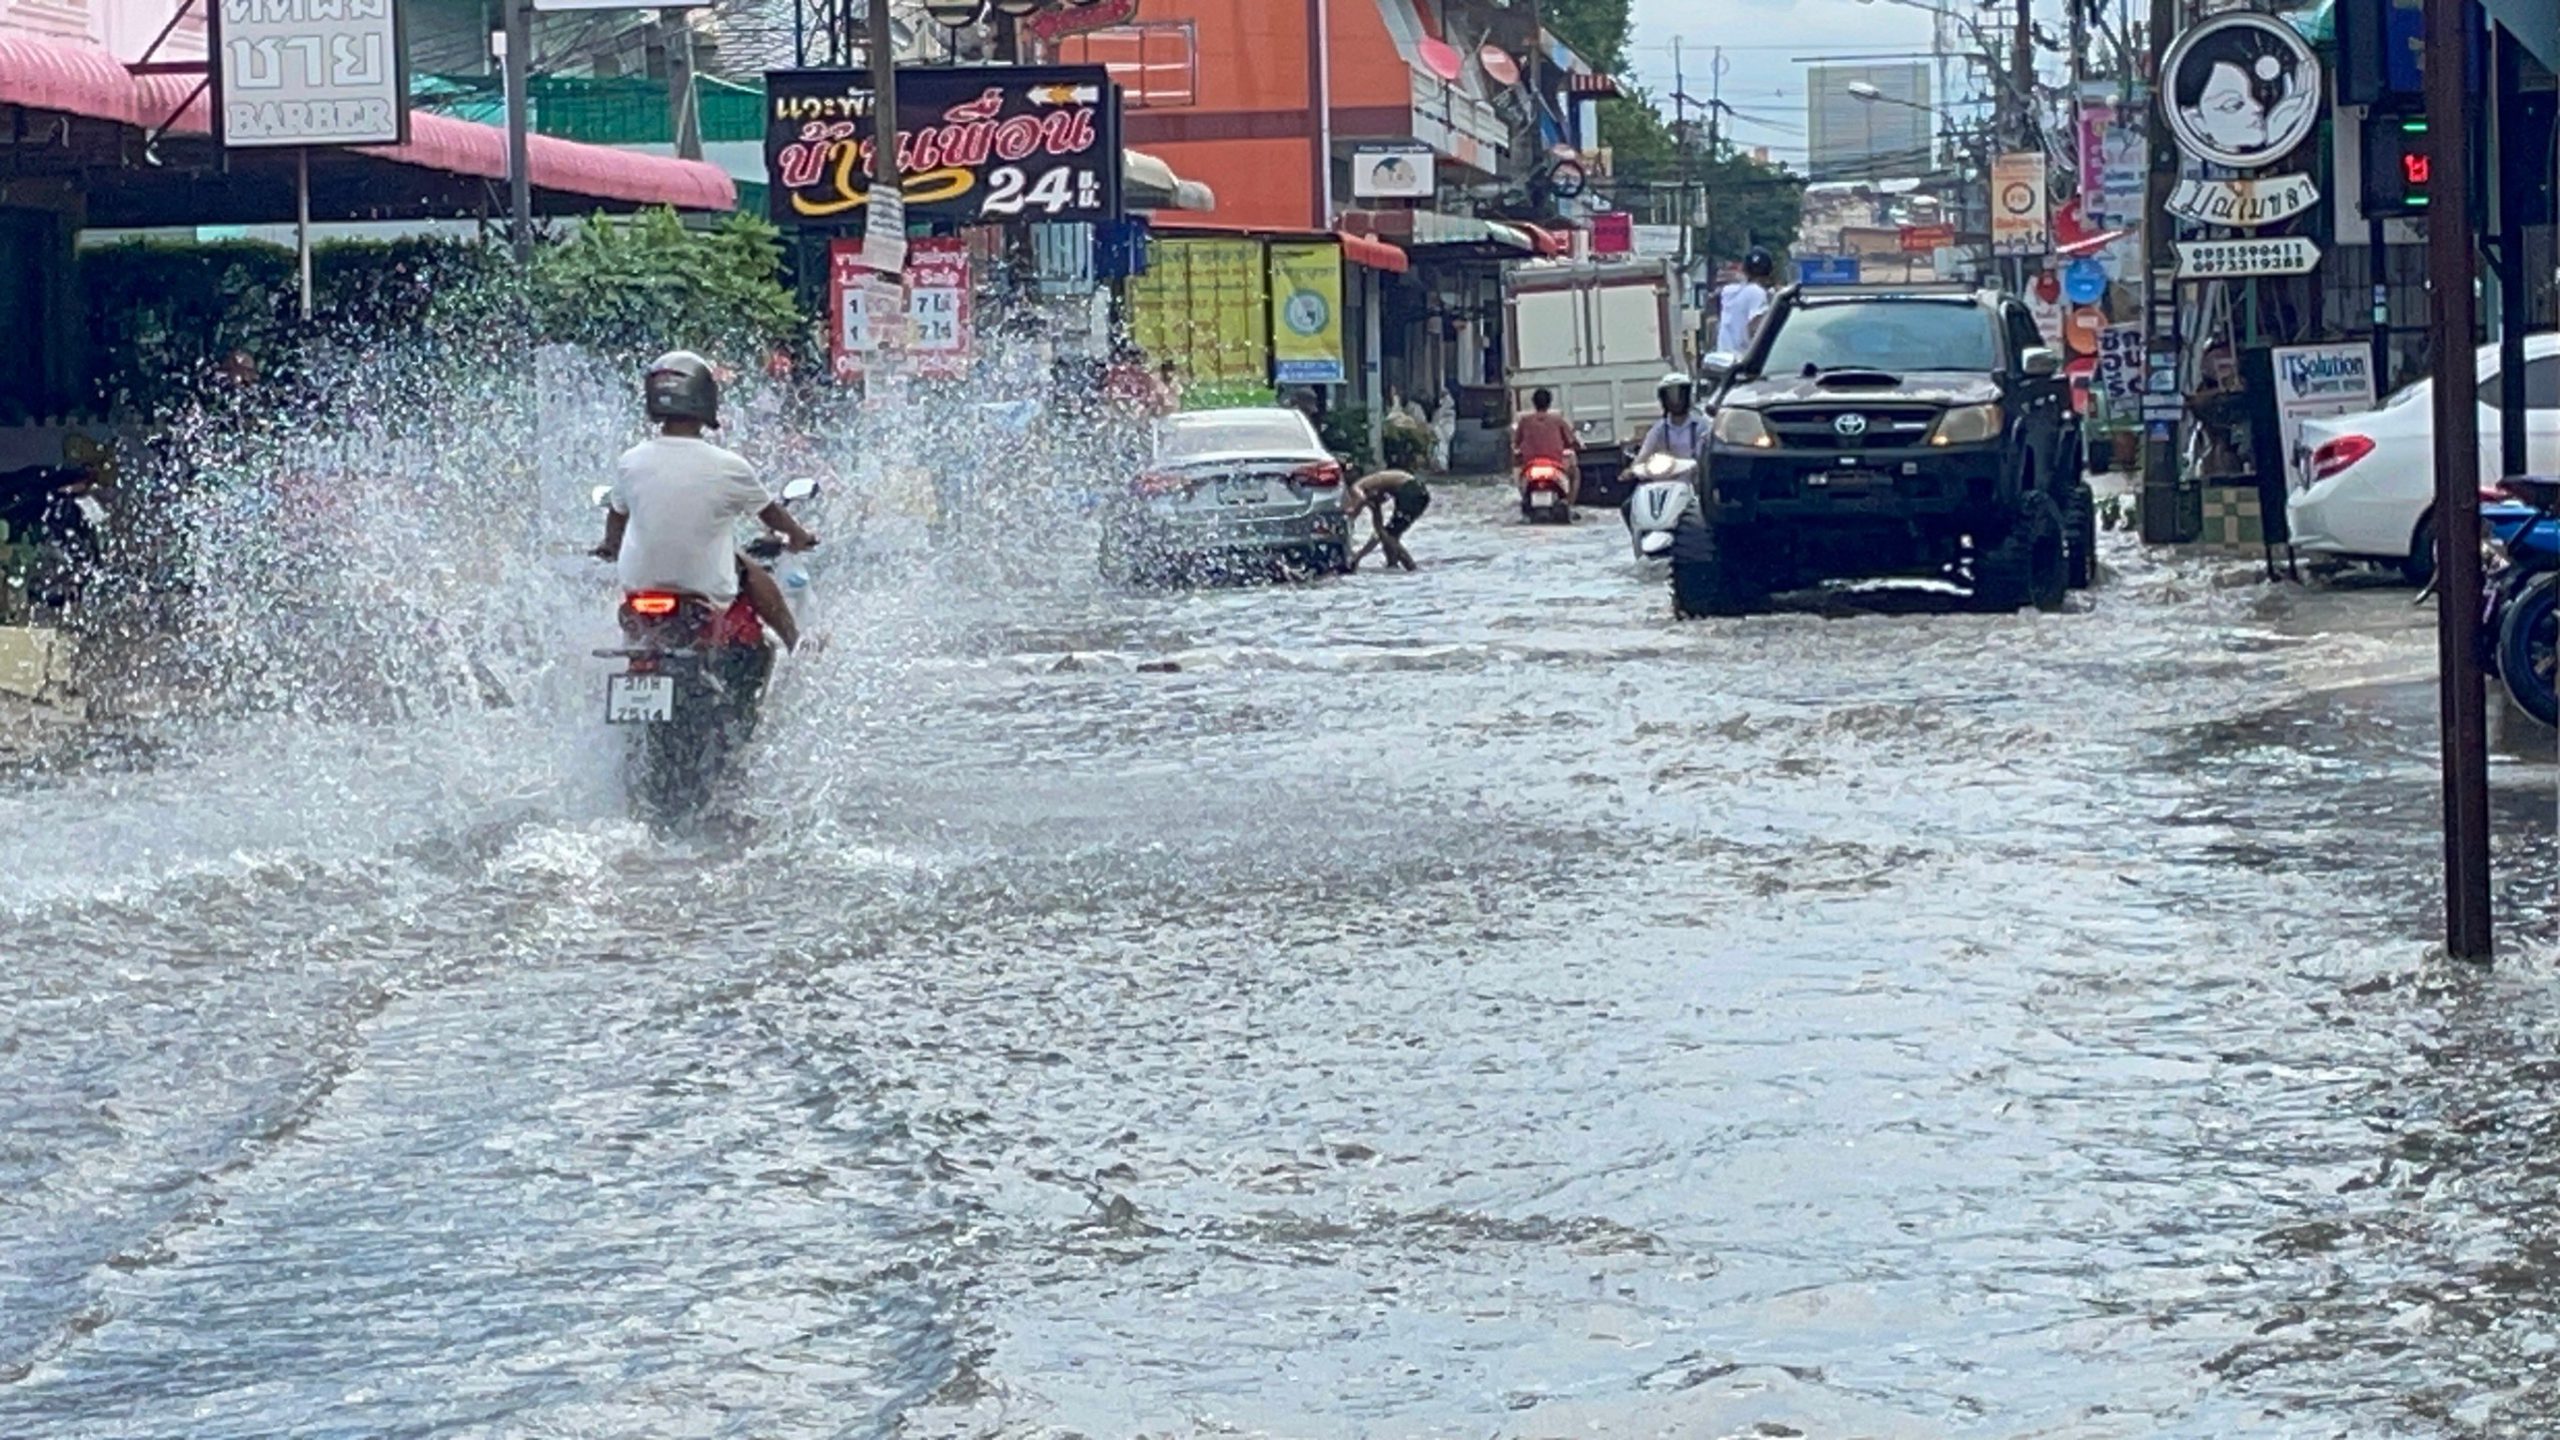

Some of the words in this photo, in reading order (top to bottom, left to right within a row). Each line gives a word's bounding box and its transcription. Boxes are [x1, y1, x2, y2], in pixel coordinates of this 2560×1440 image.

[227, 32, 383, 89] ชาย
[227, 98, 393, 139] BARBER
[981, 165, 1072, 215] 24
